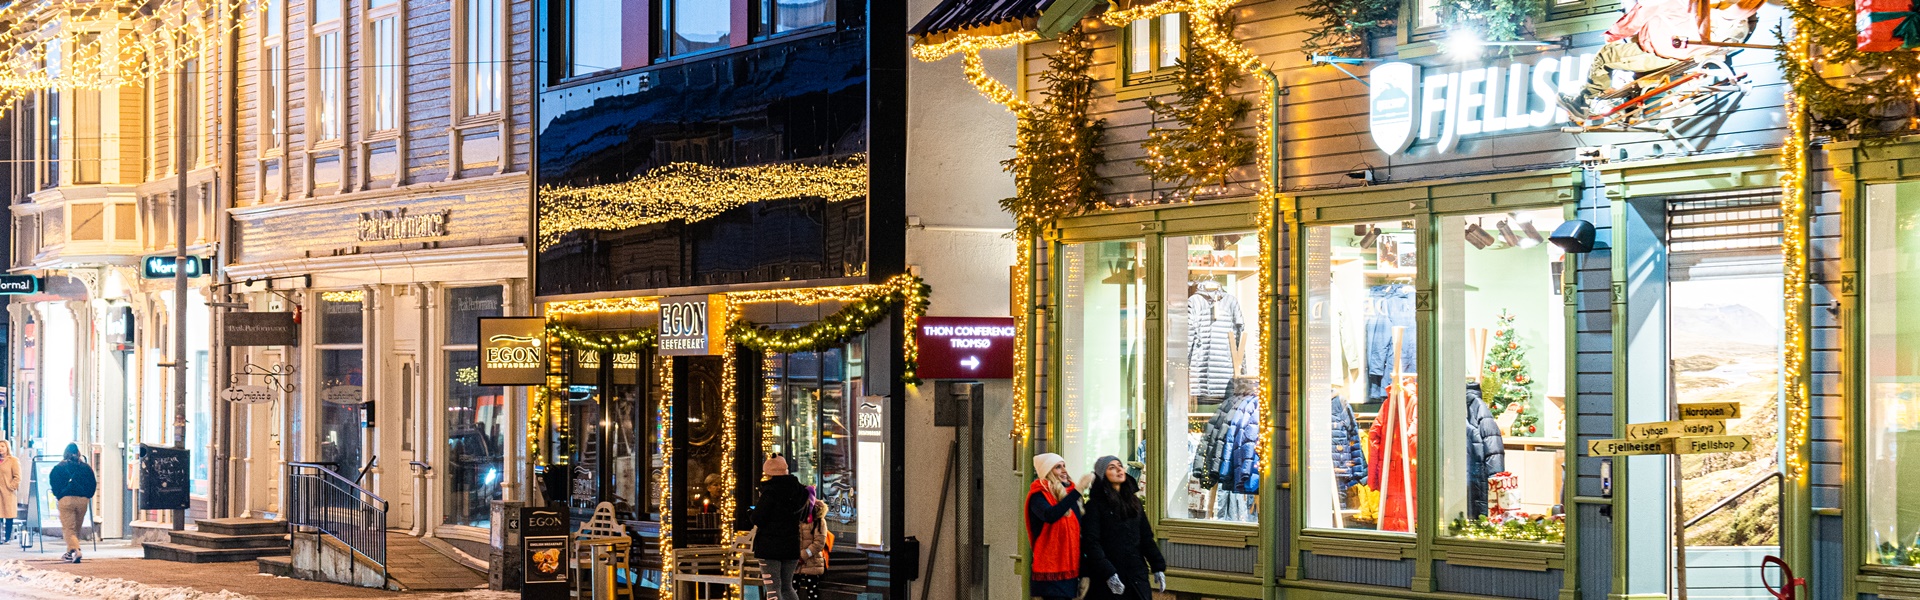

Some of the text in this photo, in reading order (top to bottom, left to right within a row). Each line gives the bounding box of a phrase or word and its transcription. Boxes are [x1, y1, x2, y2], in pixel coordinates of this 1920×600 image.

[1419, 53, 1597, 154] FJELLSH
[150, 258, 195, 274] Noral
[0, 279, 30, 290] ormal
[660, 301, 706, 337] EGON
[923, 326, 1015, 336] THON CONFERENCE
[661, 338, 705, 350] RESTAURANT
[950, 338, 991, 348] TROMSØ
[486, 346, 541, 363] EGON
[1685, 407, 1725, 418] Nordpolen
[858, 412, 881, 428] EGON
[1641, 426, 1669, 438] Lyngen
[1608, 443, 1662, 455] Fjellheisen
[1691, 440, 1735, 452] Fjellshop
[529, 517, 562, 527] EGON
